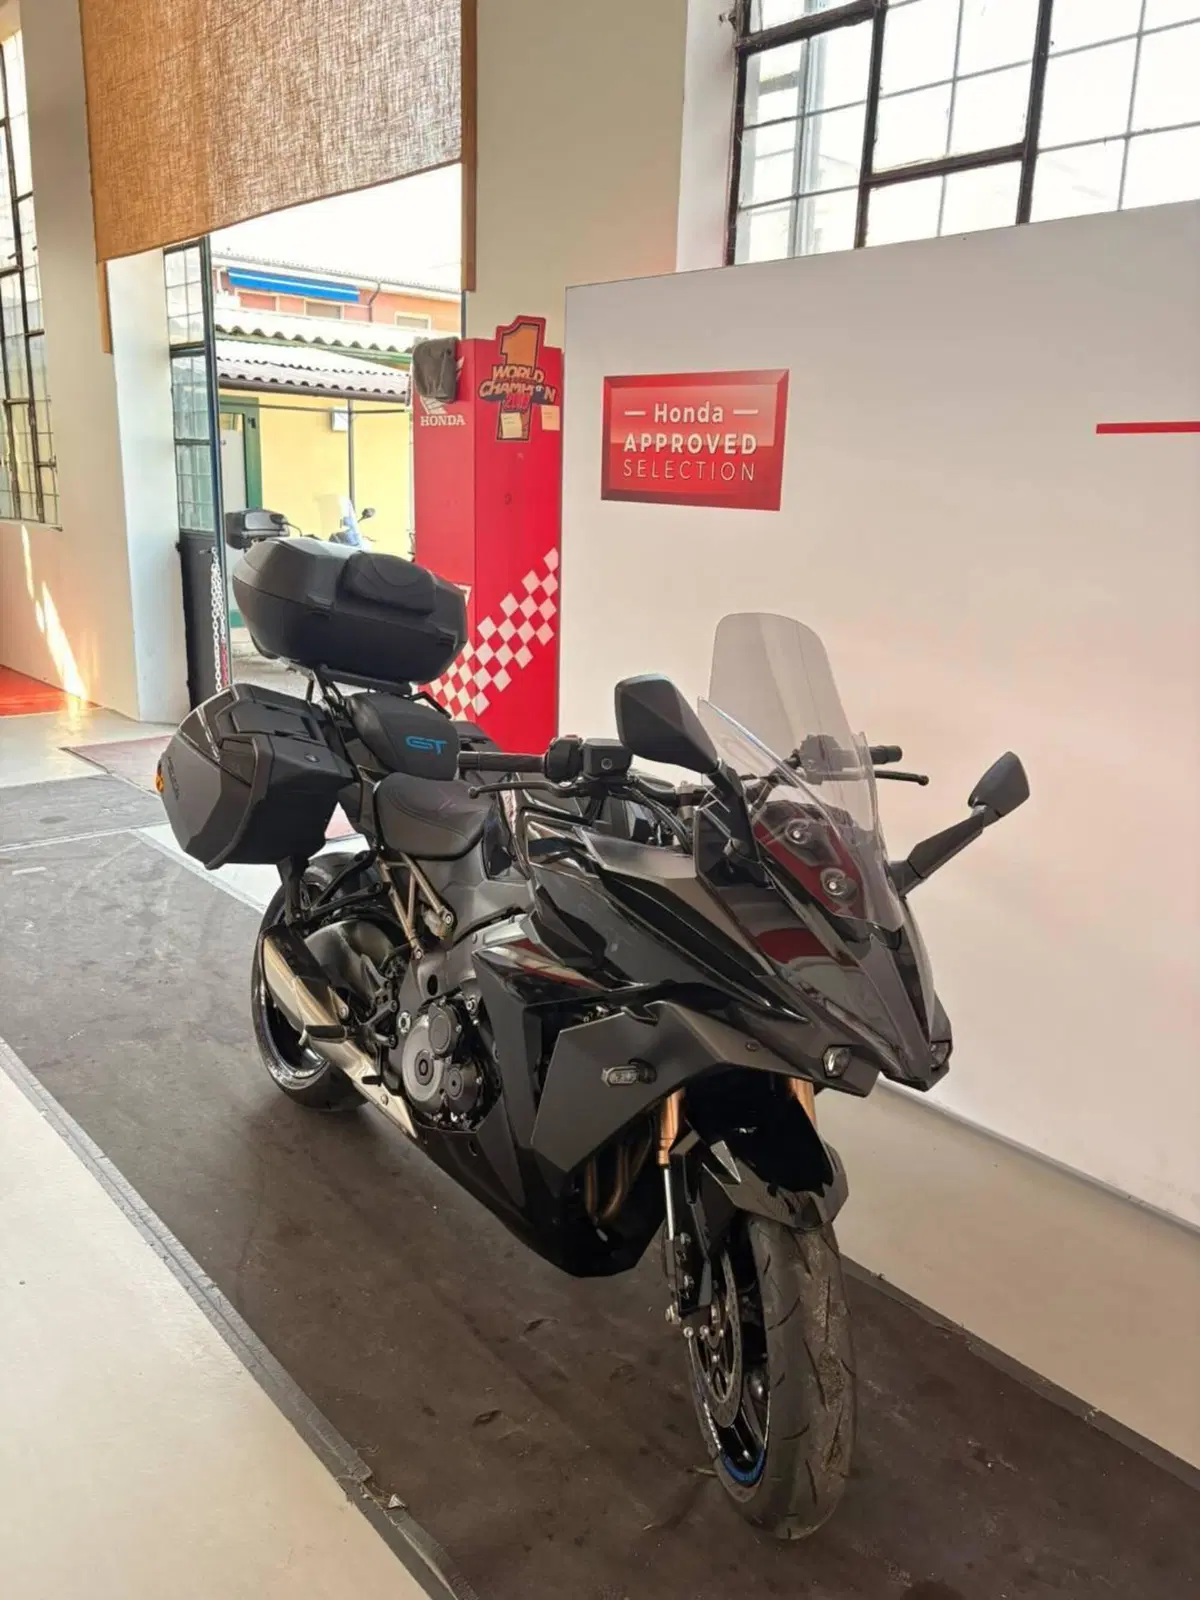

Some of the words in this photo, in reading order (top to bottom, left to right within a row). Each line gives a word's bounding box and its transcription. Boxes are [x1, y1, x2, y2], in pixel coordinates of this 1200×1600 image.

[492, 364, 545, 383] WORLD
[420, 414, 466, 427] HONDA
[654, 401, 724, 424] Honda
[623, 432, 758, 455] APPROVED
[623, 458, 756, 482] SELECTION
[405, 735, 449, 757] GT
